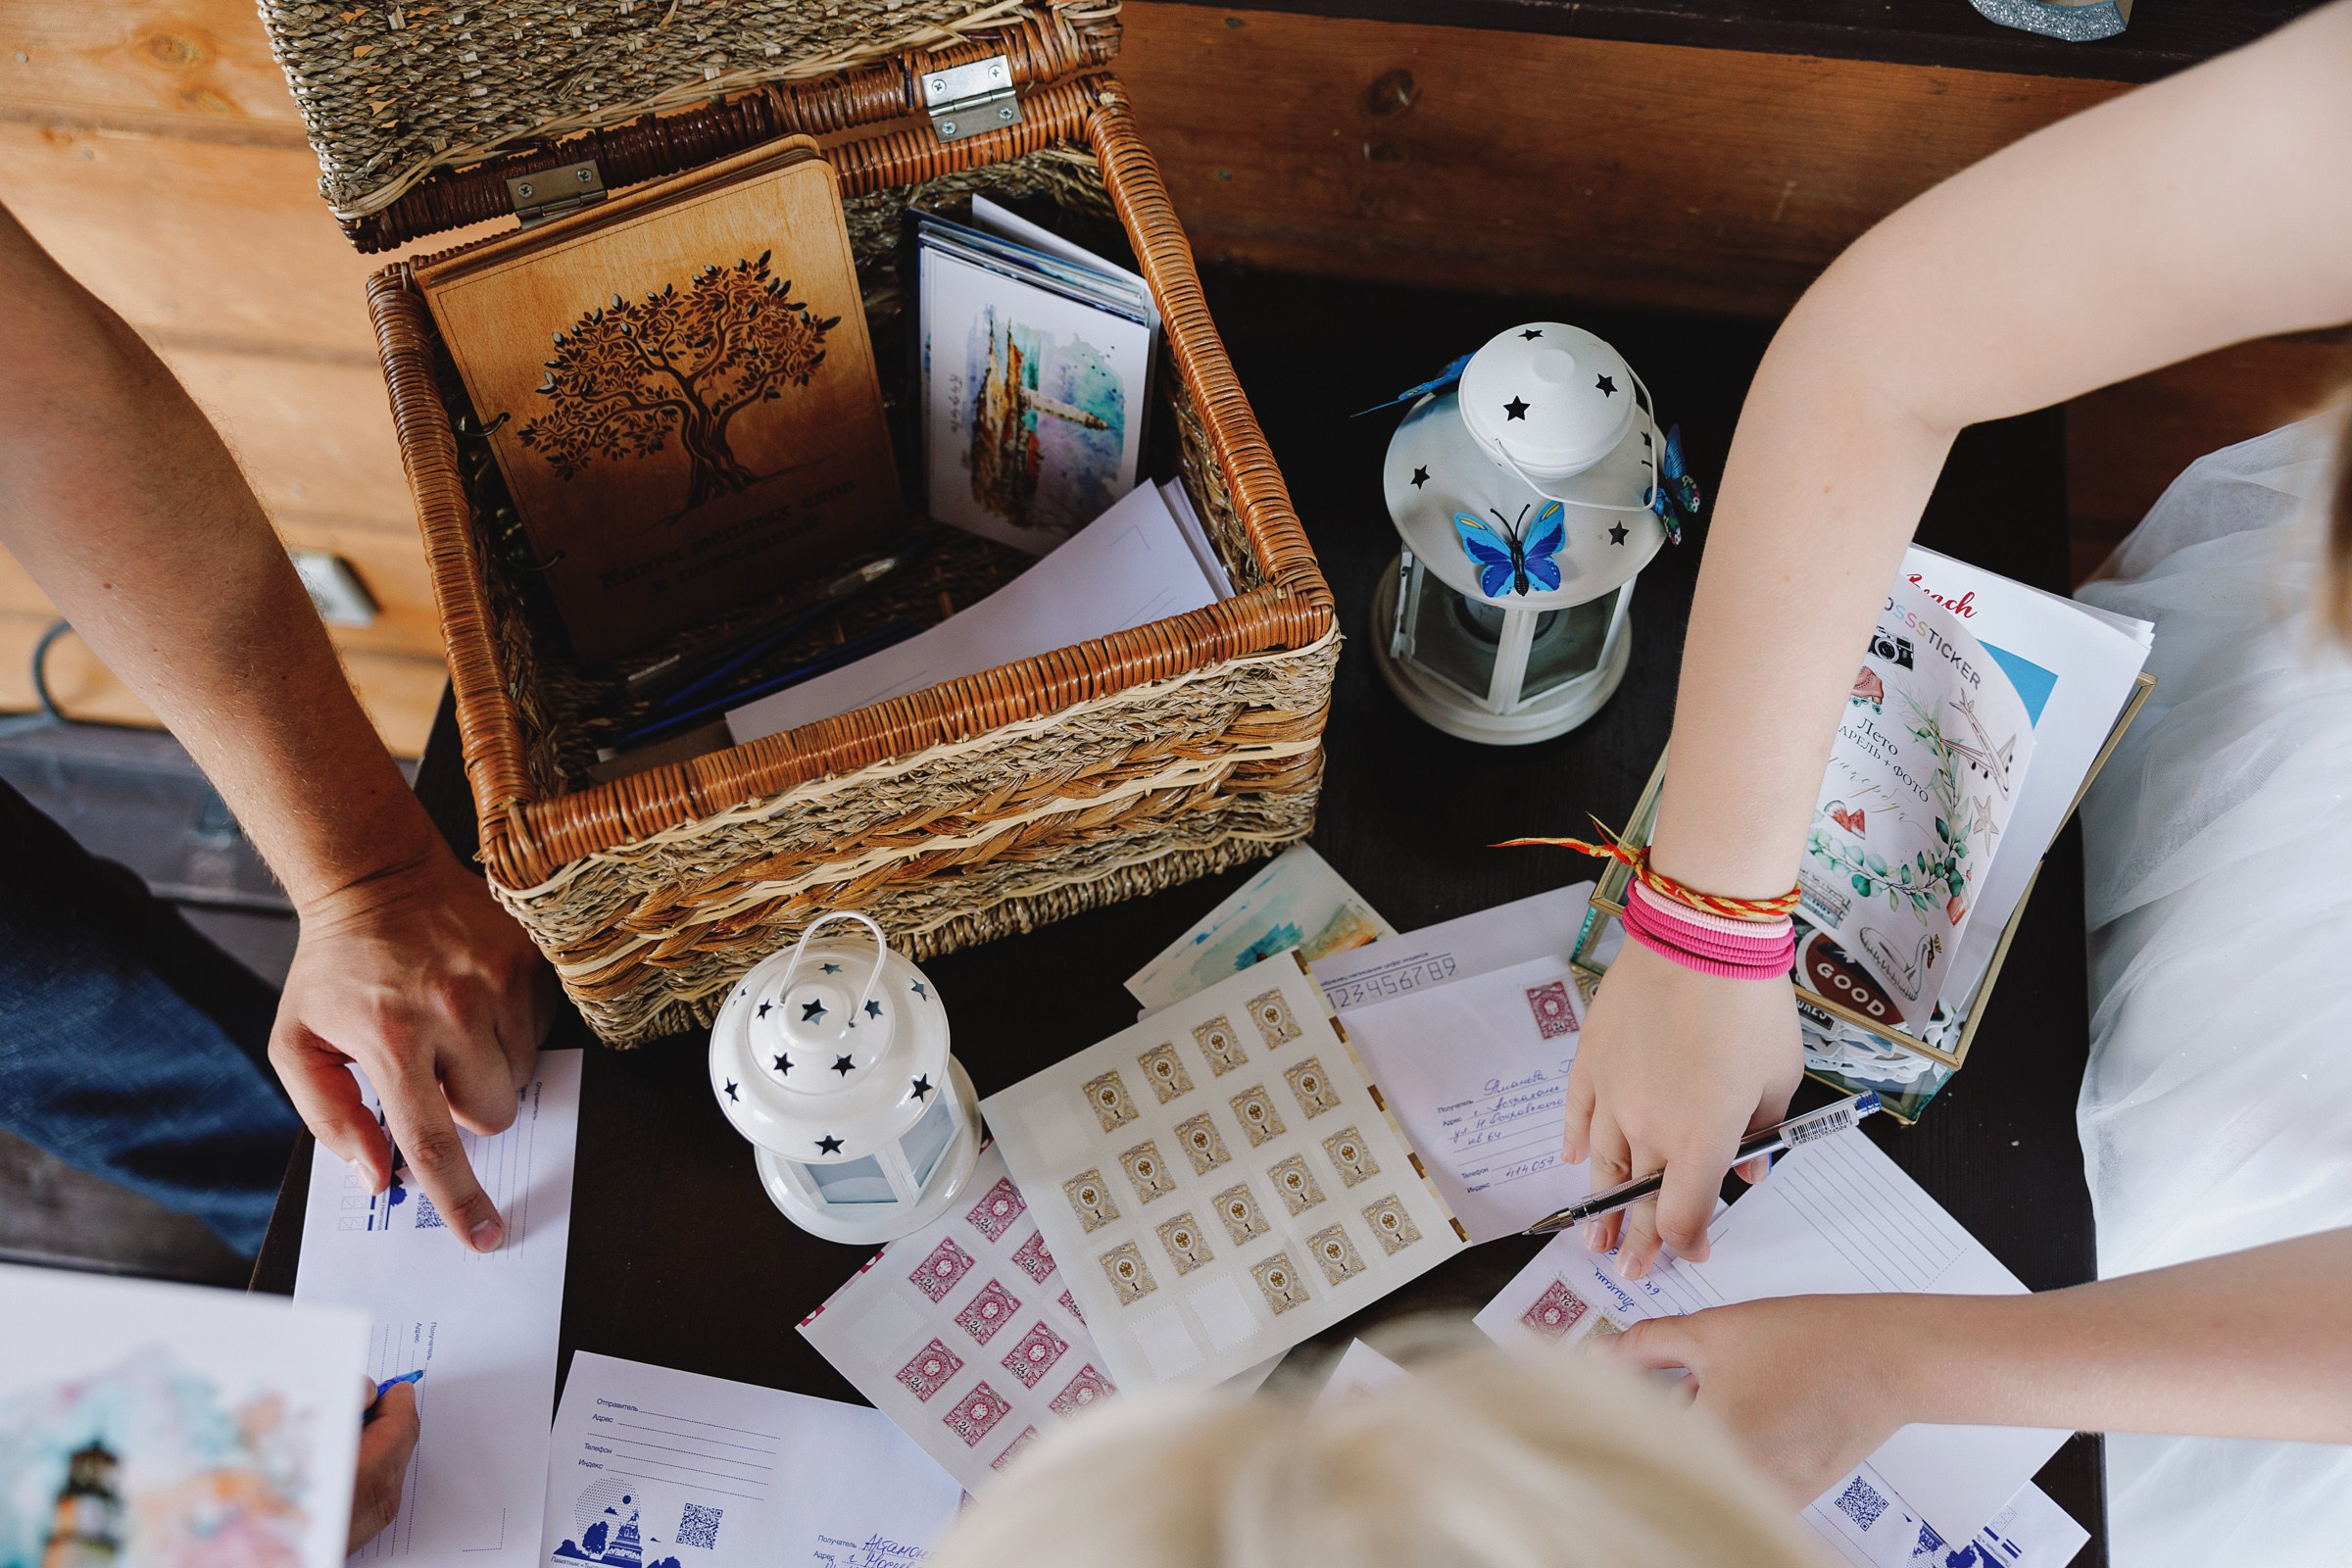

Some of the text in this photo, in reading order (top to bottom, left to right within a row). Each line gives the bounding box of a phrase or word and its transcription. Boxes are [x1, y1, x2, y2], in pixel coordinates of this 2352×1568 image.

[1857, 716, 1899, 757] Лето
[1893, 764, 1930, 804] ФОТО
[1816, 962, 1886, 1016] GOOD
[1443, 1115, 1463, 1127] Адрес
[1461, 1167, 1489, 1180] Телефон
[1466, 1181, 1491, 1194] Индекс
[981, 1218, 992, 1229] 24
[1026, 1258, 1038, 1270] 24
[923, 1279, 935, 1289] 24
[1559, 1294, 1573, 1307] 24
[969, 1321, 981, 1331] 24
[413, 1321, 422, 1345] Адрес
[426, 1320, 438, 1361] Получатель
[1016, 1363, 1028, 1374] 24
[910, 1377, 922, 1388] 24
[596, 1397, 639, 1413] Отправитель
[592, 1413, 613, 1425] Адрес
[958, 1421, 970, 1433] 24
[584, 1443, 612, 1455] Телефон
[578, 1458, 604, 1471] Индекс
[817, 1535, 858, 1548] Получатель
[812, 1550, 836, 1561] Адрес
